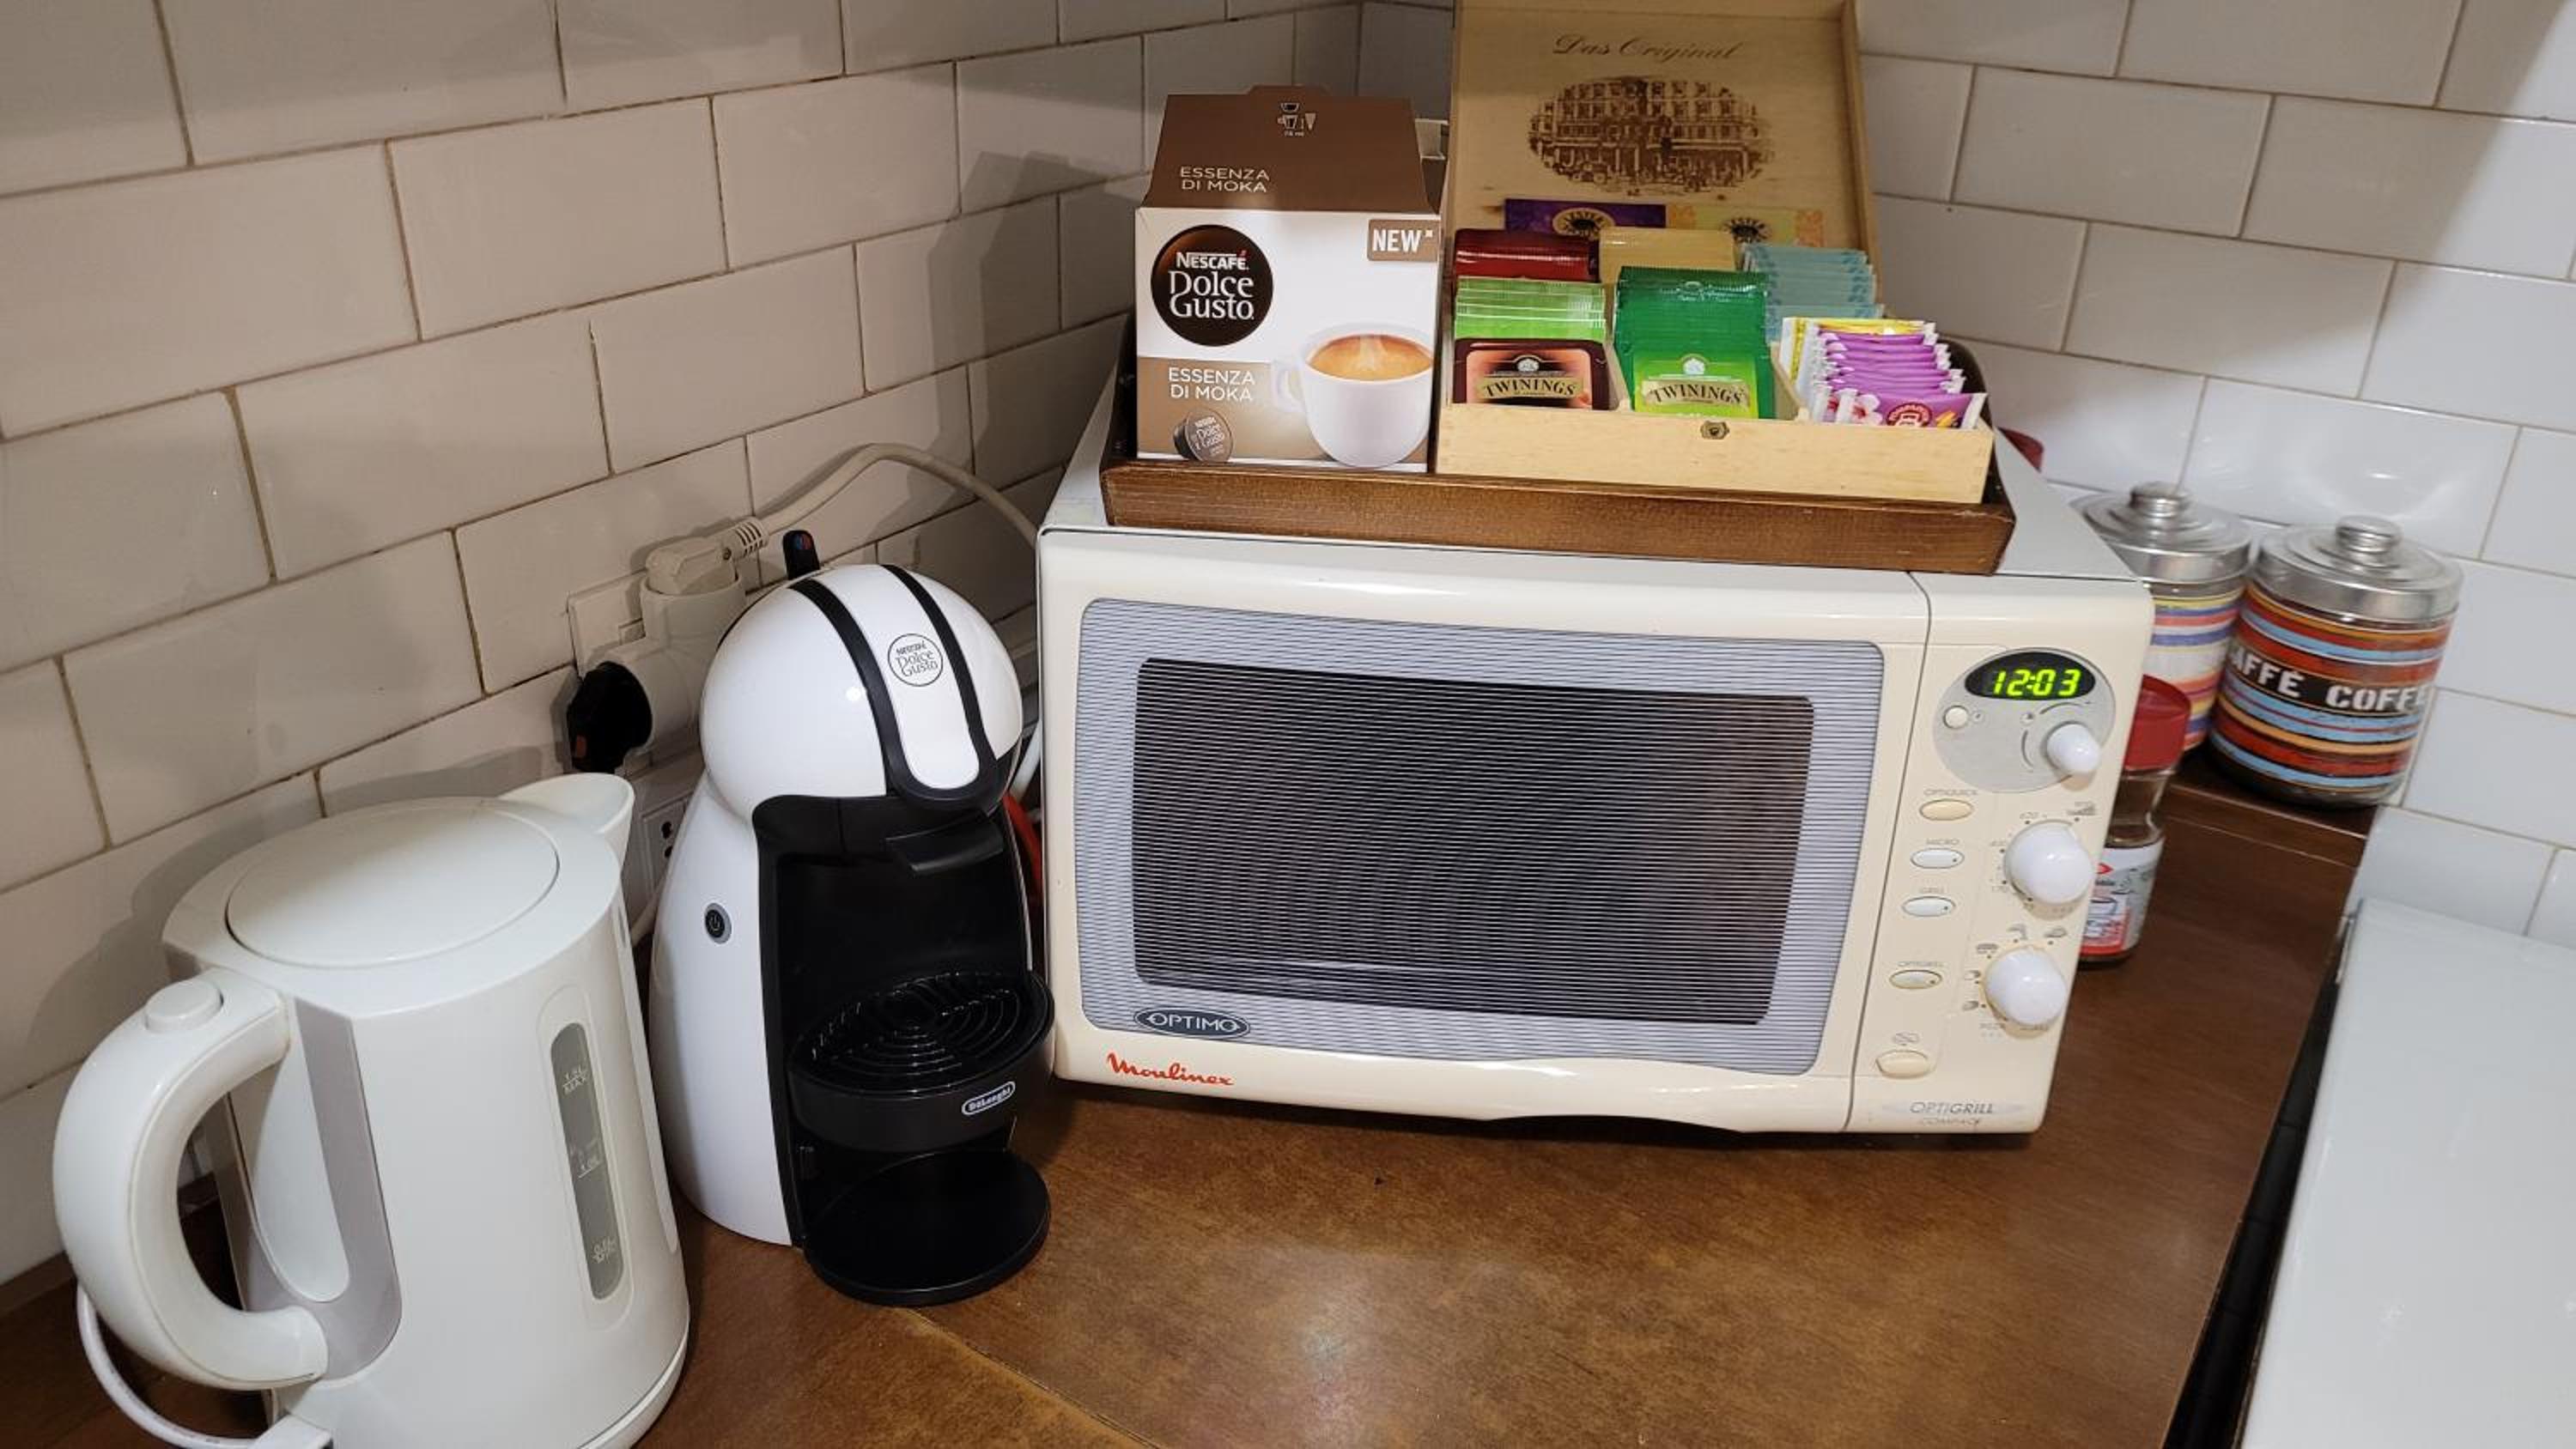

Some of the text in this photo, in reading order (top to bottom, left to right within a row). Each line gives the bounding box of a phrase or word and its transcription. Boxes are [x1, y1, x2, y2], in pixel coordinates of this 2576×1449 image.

[1552, 34, 1743, 63] Das Original
[1180, 167, 1270, 181] ESSENZA
[1182, 179, 1267, 193] DI MOKA
[1168, 270, 1255, 298] Dolce
[1170, 294, 1255, 320] Gusto
[1169, 367, 1255, 385] ESSENZA
[1170, 385, 1254, 401] DI MOKA
[1484, 379, 1575, 397] TWININGS
[1649, 384, 1745, 404] TWININGS
[896, 651, 934, 670] Dolce
[902, 661, 939, 676] Gusto
[1993, 669, 2081, 696] 12:03
[1146, 1012, 1241, 1032] OPTIMO
[1107, 1052, 1234, 1086] Moulinex
[1909, 1101, 1993, 1114] OPTIGRILL
